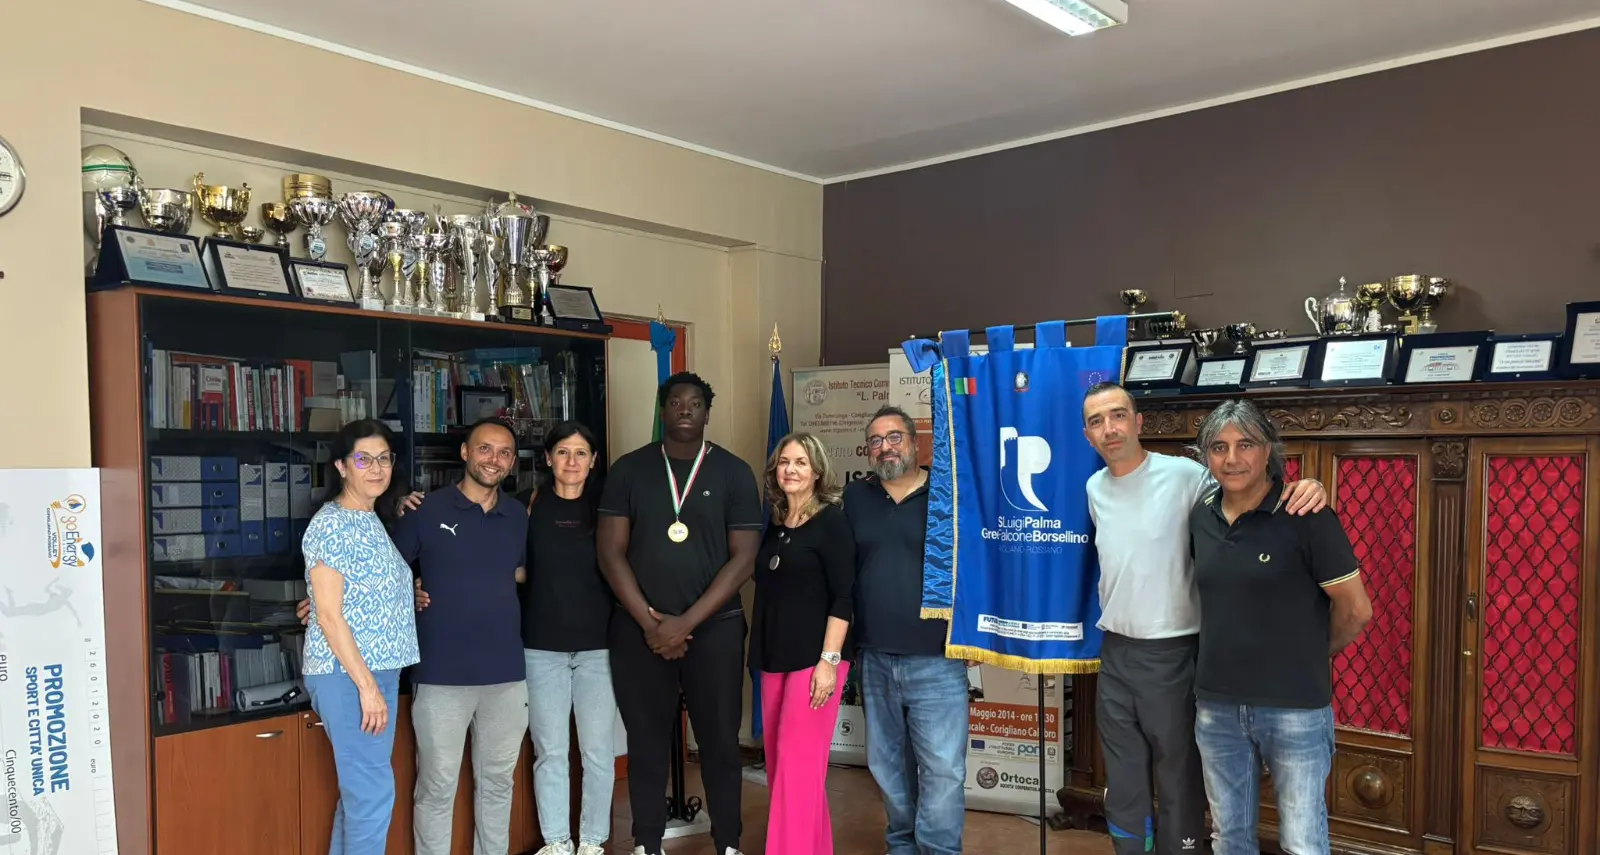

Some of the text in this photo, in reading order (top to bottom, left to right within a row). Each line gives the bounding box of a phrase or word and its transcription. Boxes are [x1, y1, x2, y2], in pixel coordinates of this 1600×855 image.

[828, 382, 849, 390] Istituto
[850, 379, 873, 389] Tecnico
[899, 376, 932, 385] ISTITUTO
[60, 515, 80, 568] goEnergy
[25, 666, 39, 706] SPORT
[27, 708, 40, 718] E
[969, 707, 997, 720] Maggio
[997, 710, 1016, 720] 2014
[1020, 713, 1033, 722] ore
[43, 663, 70, 793] PROMOZIONE
[989, 724, 1028, 736] Corigliano
[1028, 727, 1057, 739] Calbro
[30, 757, 45, 797] UNICA
[4, 749, 22, 834] Cinquecento/00
